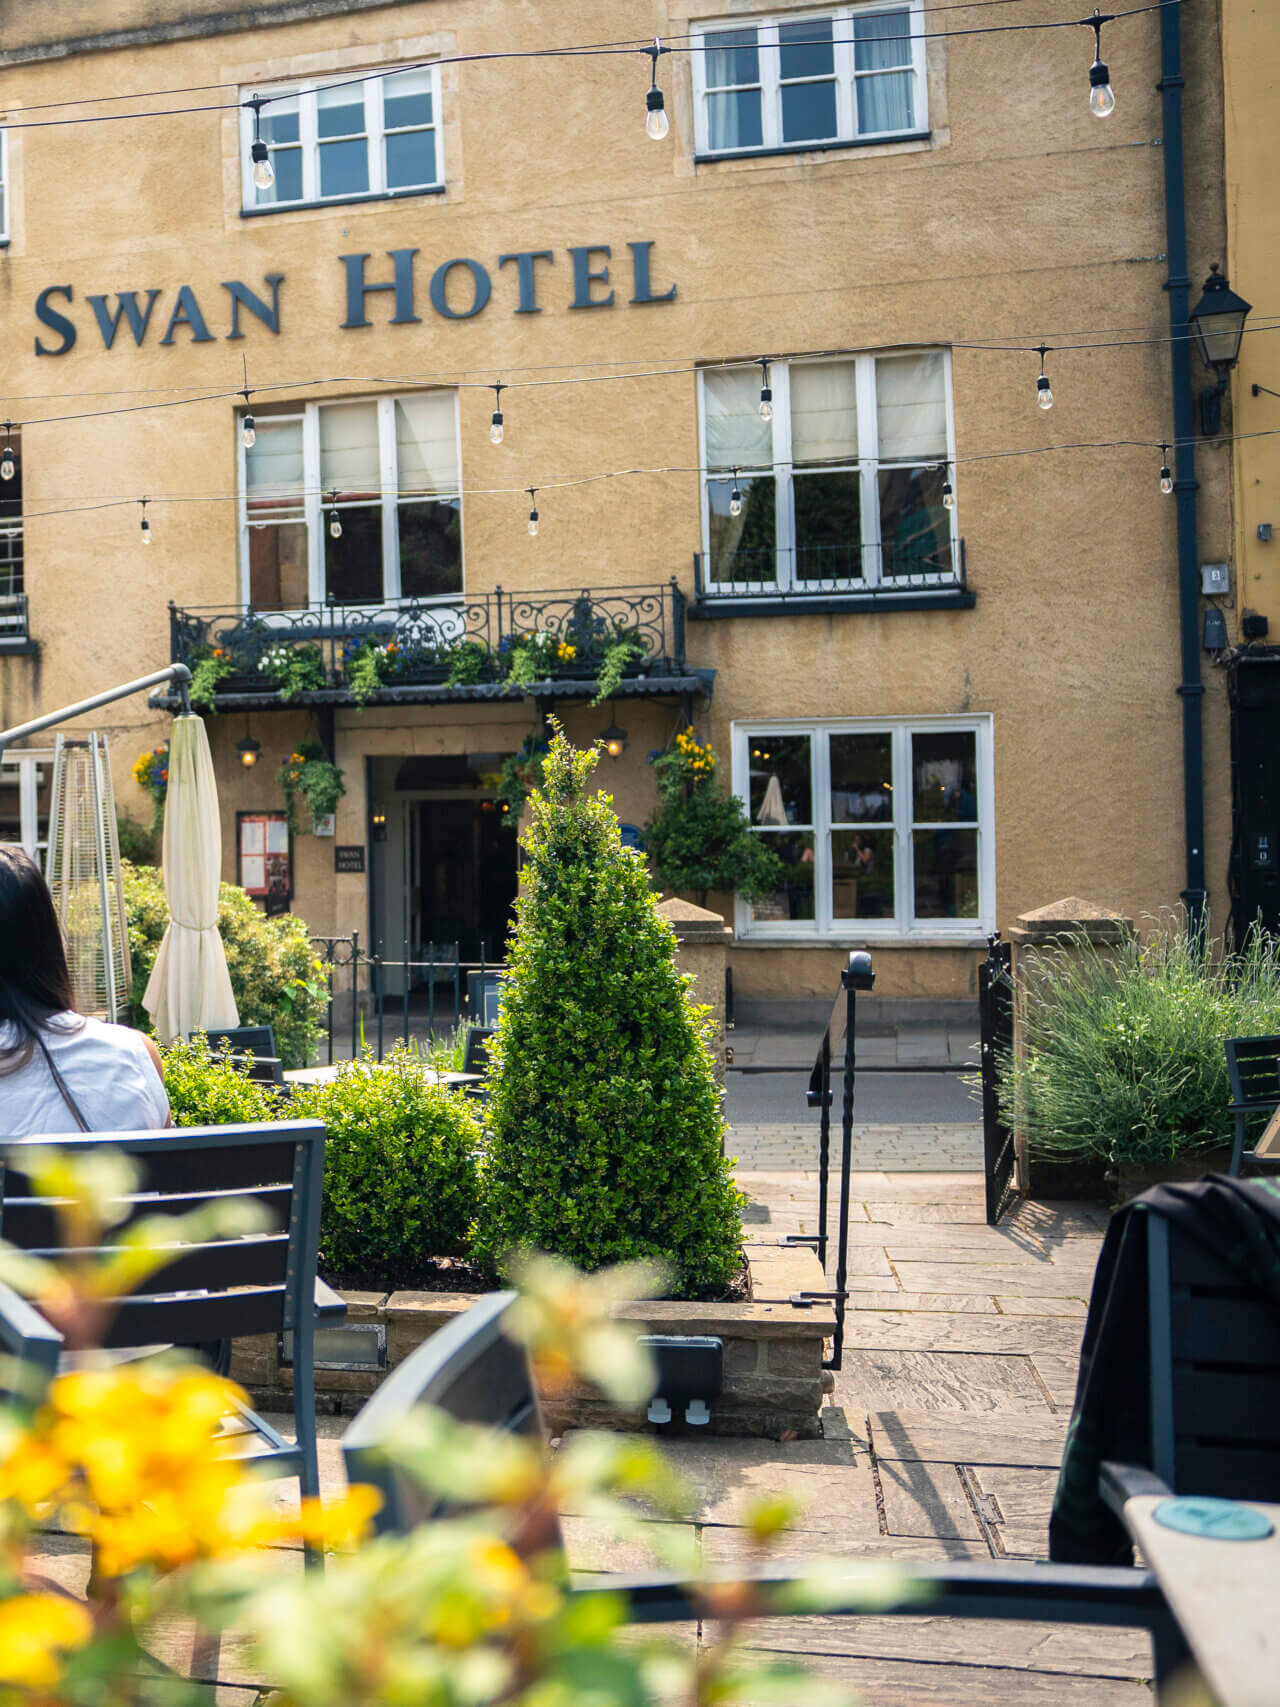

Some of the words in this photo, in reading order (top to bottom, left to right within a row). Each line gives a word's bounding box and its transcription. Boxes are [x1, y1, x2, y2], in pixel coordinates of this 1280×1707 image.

[34, 274, 285, 357] SWAN
[338, 241, 678, 330] HOTEL
[338, 860, 362, 870] HOTEL
